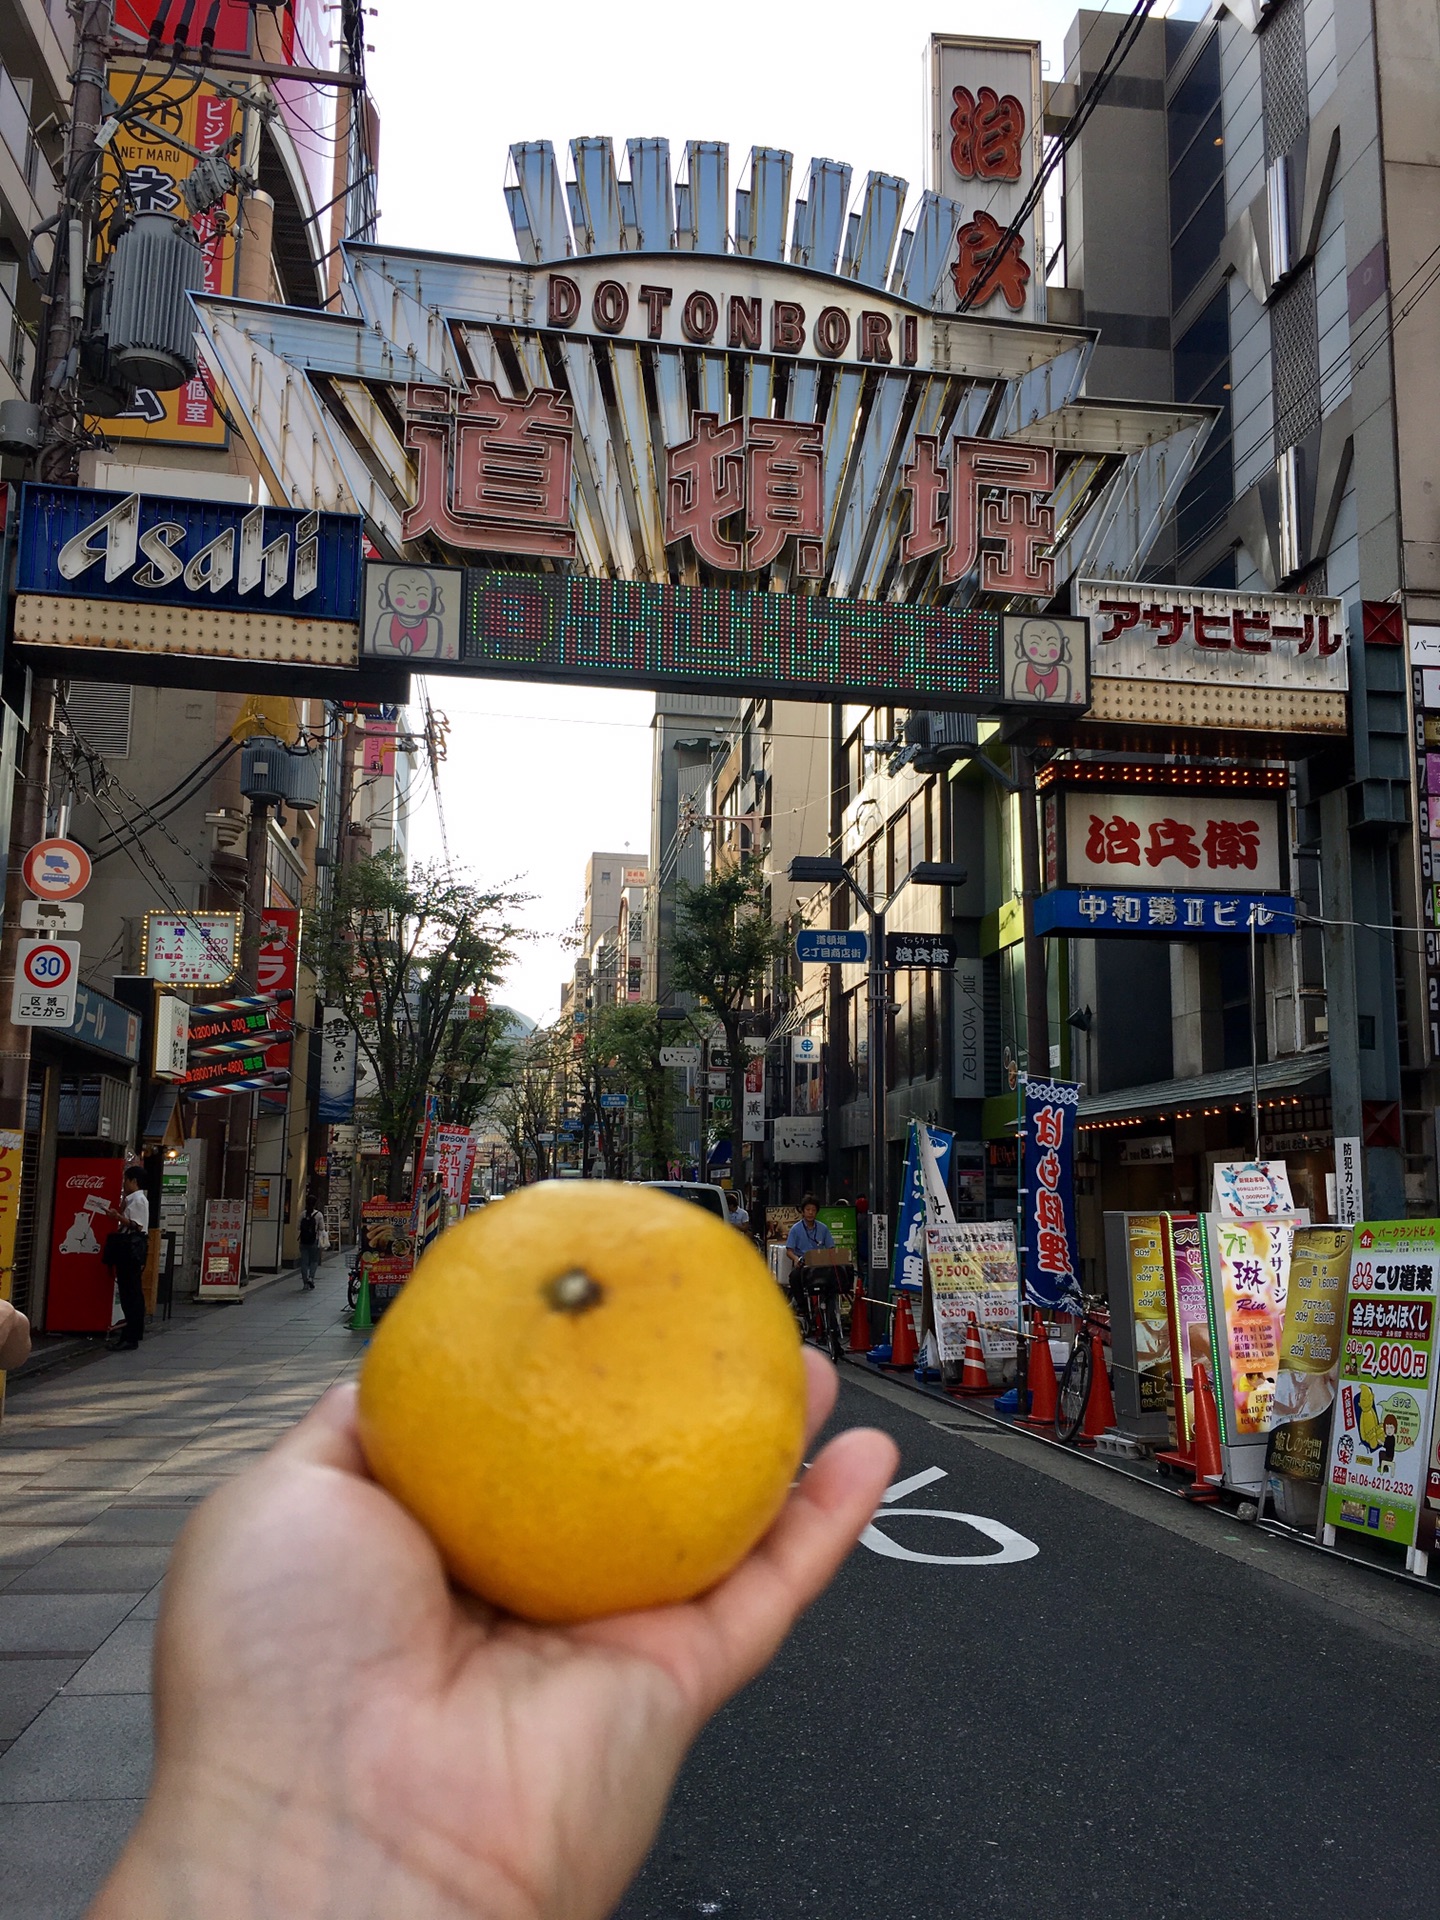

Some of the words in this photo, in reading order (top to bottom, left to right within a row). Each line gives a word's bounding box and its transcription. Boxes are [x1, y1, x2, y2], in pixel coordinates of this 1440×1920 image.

[121, 146, 143, 159] NET
[146, 148, 180, 163] MARU
[548, 273, 919, 366] DOTONBORI
[401, 377, 1056, 597] 道頓堀
[58, 492, 320, 600] Asahi
[1098, 600, 1342, 655] アサヒビール
[1085, 814, 1260, 870] 治兵衛
[816, 935, 847, 946] 道頓堀
[802, 948, 861, 959] 2丁目商店街
[896, 946, 950, 963] 治兵衛
[35, 956, 60, 976] 30
[31, 996, 57, 1006] 区域
[20, 1006, 65, 1017] ここから
[443, 1126, 465, 1134] カラオケ
[449, 1144, 462, 1198] アルコール
[1378, 1225, 1436, 1238] パークランドビル
[1223, 1233, 1247, 1257] 7F
[1334, 1235, 1346, 1248] 8F
[1361, 1235, 1372, 1246] 4F
[1266, 1226, 1287, 1304] マッサージ
[204, 1272, 237, 1283] OPEN
[1232, 1259, 1266, 1294] 琳
[1298, 1278, 1312, 1289] 30分
[1318, 1278, 1339, 1290] 1,600円
[1374, 1264, 1433, 1292] こり道楽
[1236, 1298, 1268, 1312] Rin
[1302, 1299, 1332, 1311] アロマオイル
[1295, 1311, 1308, 1323] 30分
[1352, 1302, 1428, 1331] 全身もみほぐし
[1352, 1327, 1363, 1336] Body
[1290, 1345, 1304, 1356] 20分
[1362, 1343, 1426, 1375] 2,800円
[1275, 1430, 1322, 1460] 癒しの空間
